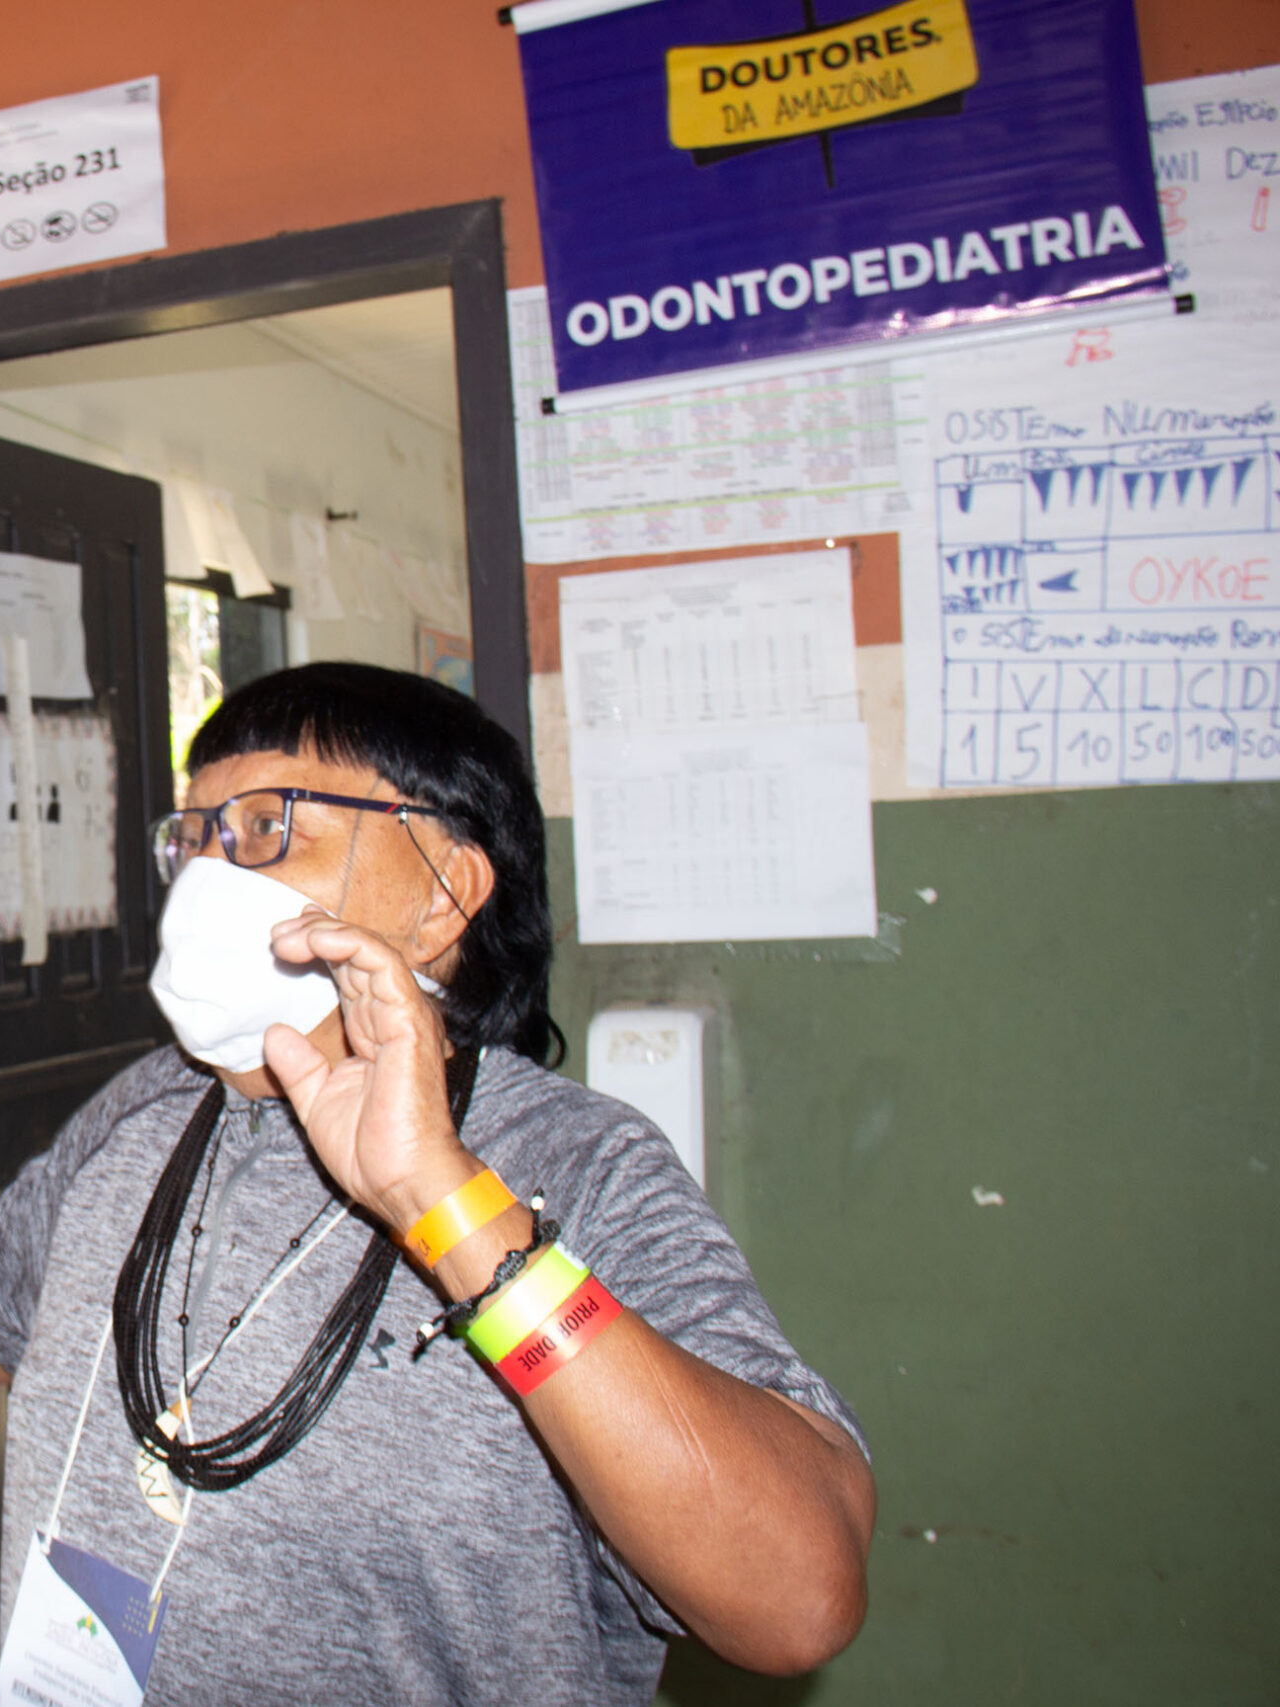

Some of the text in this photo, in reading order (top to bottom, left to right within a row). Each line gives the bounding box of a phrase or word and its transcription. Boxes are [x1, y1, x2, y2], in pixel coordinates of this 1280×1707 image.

[700, 18, 935, 95] DOUTORES
[722, 67, 915, 135] DA AMAZÔNIA
[74, 147, 121, 178] 231
[565, 205, 1144, 346] ODONTOPEDIATRIA
[1011, 672, 1047, 712] V
[1079, 667, 1109, 712] X
[1141, 666, 1163, 711] L
[1187, 666, 1214, 711] C
[1241, 665, 1270, 711] D
[960, 724, 977, 776] 1
[1010, 722, 1042, 780] 5
[1067, 729, 1112, 768] 10
[1129, 721, 1172, 761] 50
